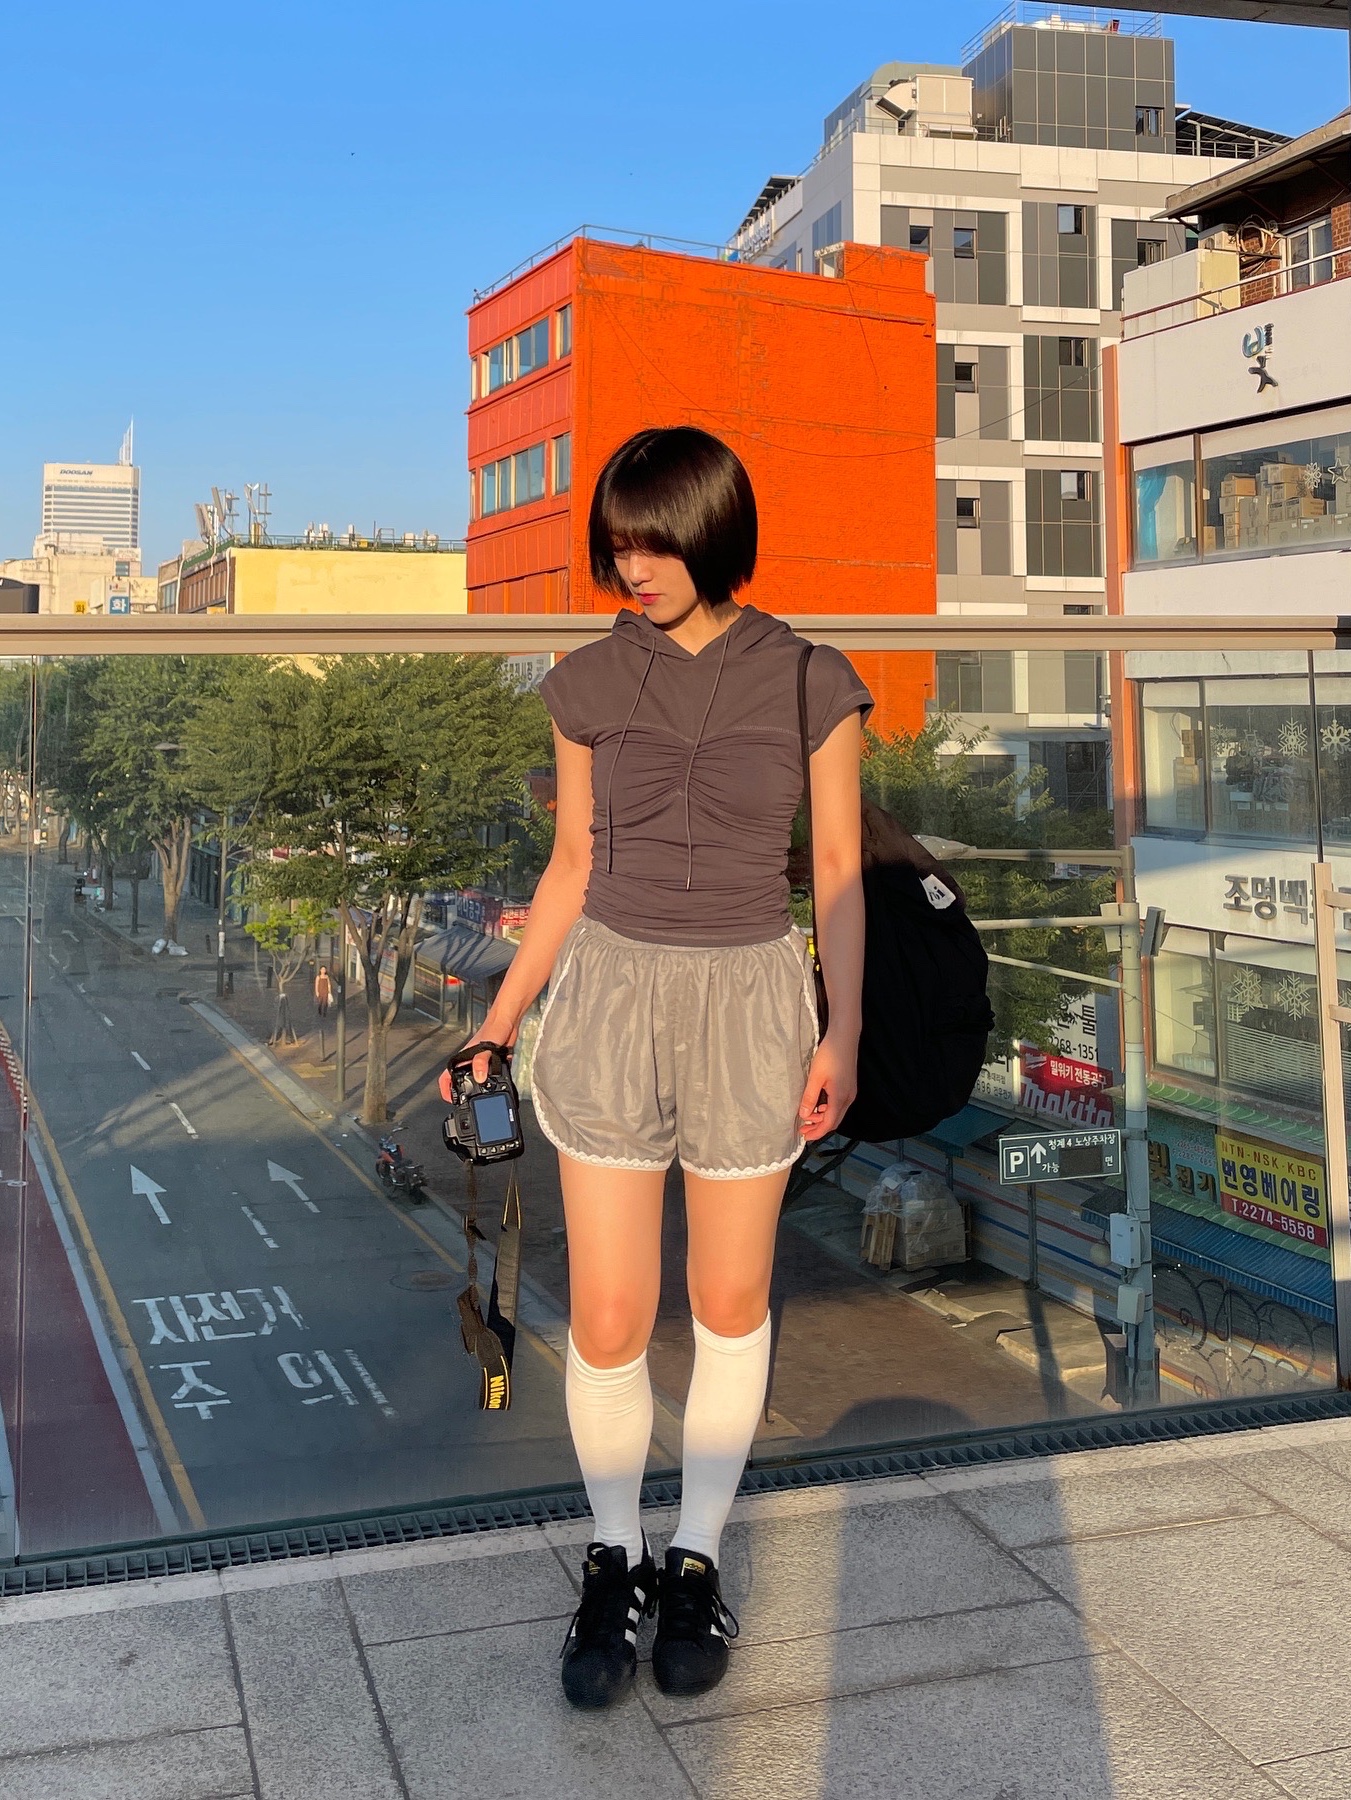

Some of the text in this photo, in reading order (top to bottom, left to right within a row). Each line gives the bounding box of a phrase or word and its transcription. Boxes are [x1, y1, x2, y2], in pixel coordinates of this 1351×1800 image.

[1223, 874, 1351, 930] 조명백
[1050, 1060, 1074, 1081] 밀워키
[1010, 1151, 1024, 1173] P
[1075, 1133, 1115, 1147] 노상주차장
[1042, 1156, 1113, 1173] 가능 면
[1221, 1157, 1320, 1219] 번영베어링
[1232, 1198, 1315, 1240] T.2274-5558
[489, 1375, 505, 1409] Nikon
